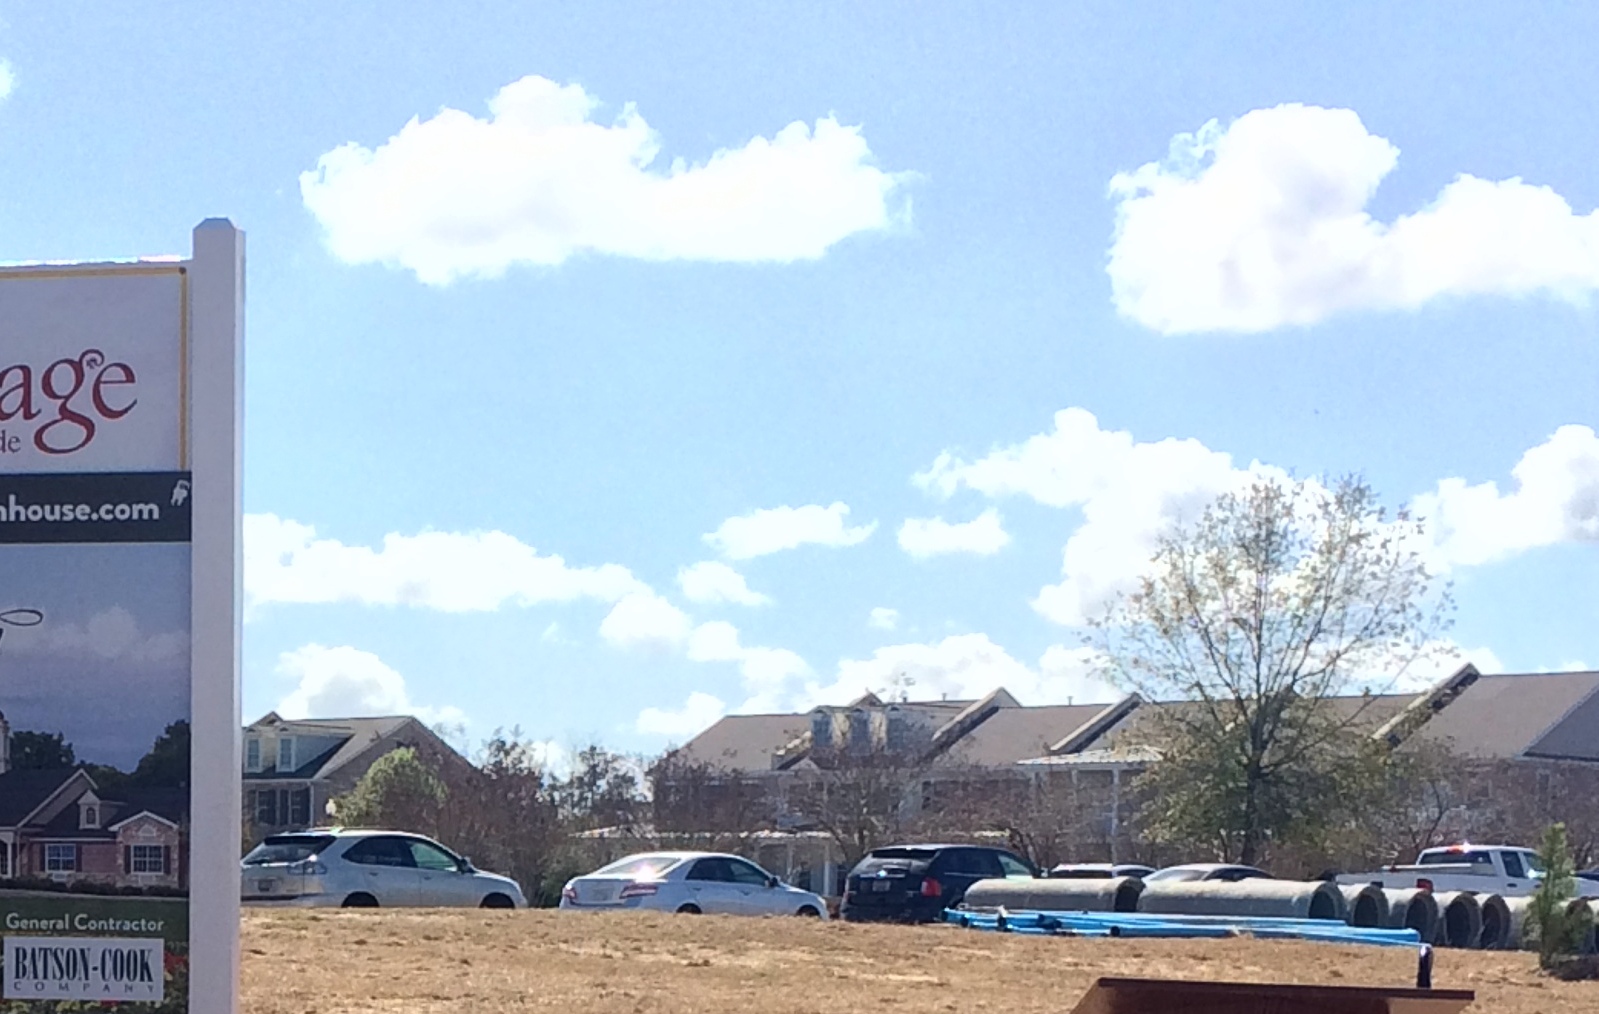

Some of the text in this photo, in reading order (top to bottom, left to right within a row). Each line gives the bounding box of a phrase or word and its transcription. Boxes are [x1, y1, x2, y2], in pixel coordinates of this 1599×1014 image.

[6, 912, 165, 931] General Contractor
[14, 946, 154, 983] BATSON-COOK
[13, 981, 154, 993] COMPANY
